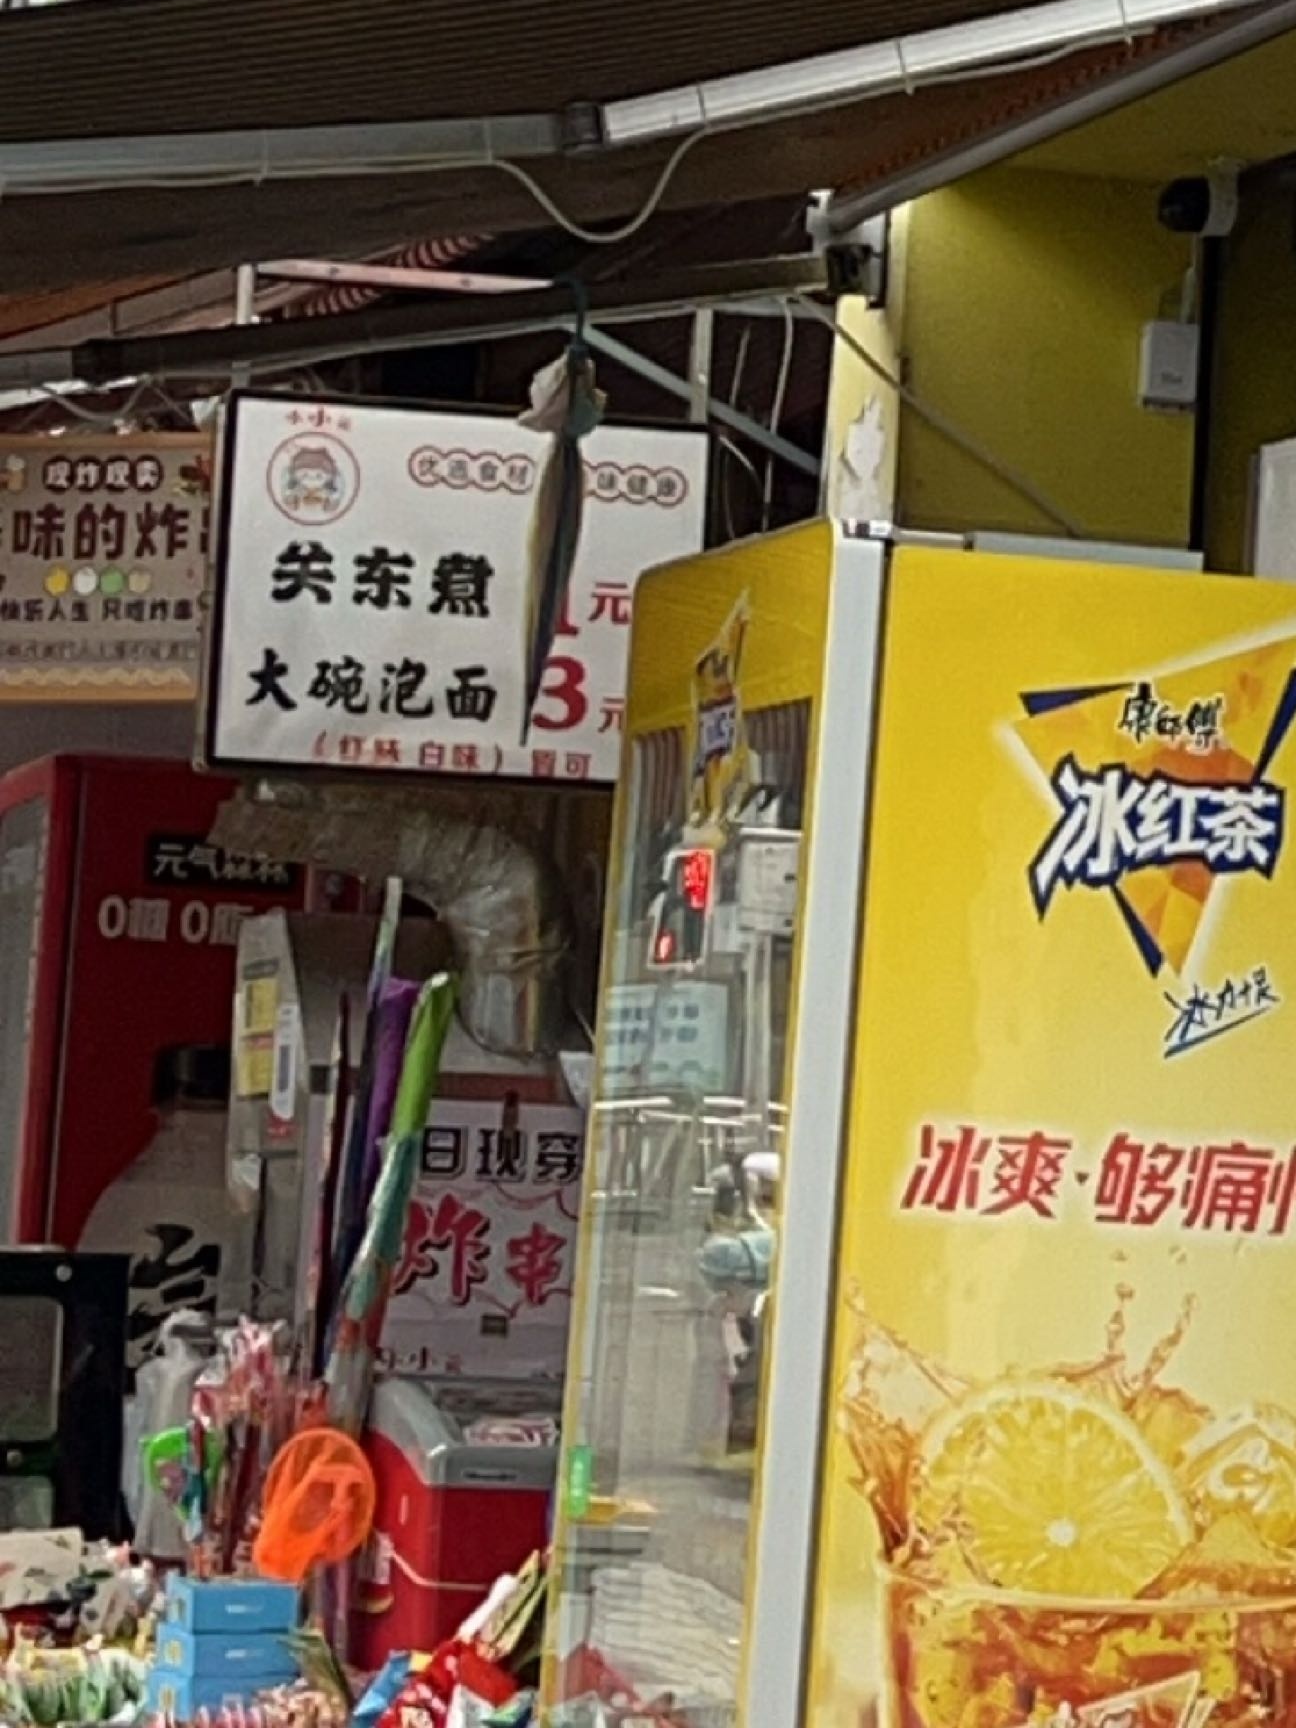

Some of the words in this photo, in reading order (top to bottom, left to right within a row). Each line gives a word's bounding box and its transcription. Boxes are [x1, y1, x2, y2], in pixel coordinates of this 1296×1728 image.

[270, 540, 495, 618] 关东煮
[245, 648, 498, 722] 大碗泡面
[1034, 760, 1278, 898] 冰红茶
[390, 1193, 568, 1307] 炸串
